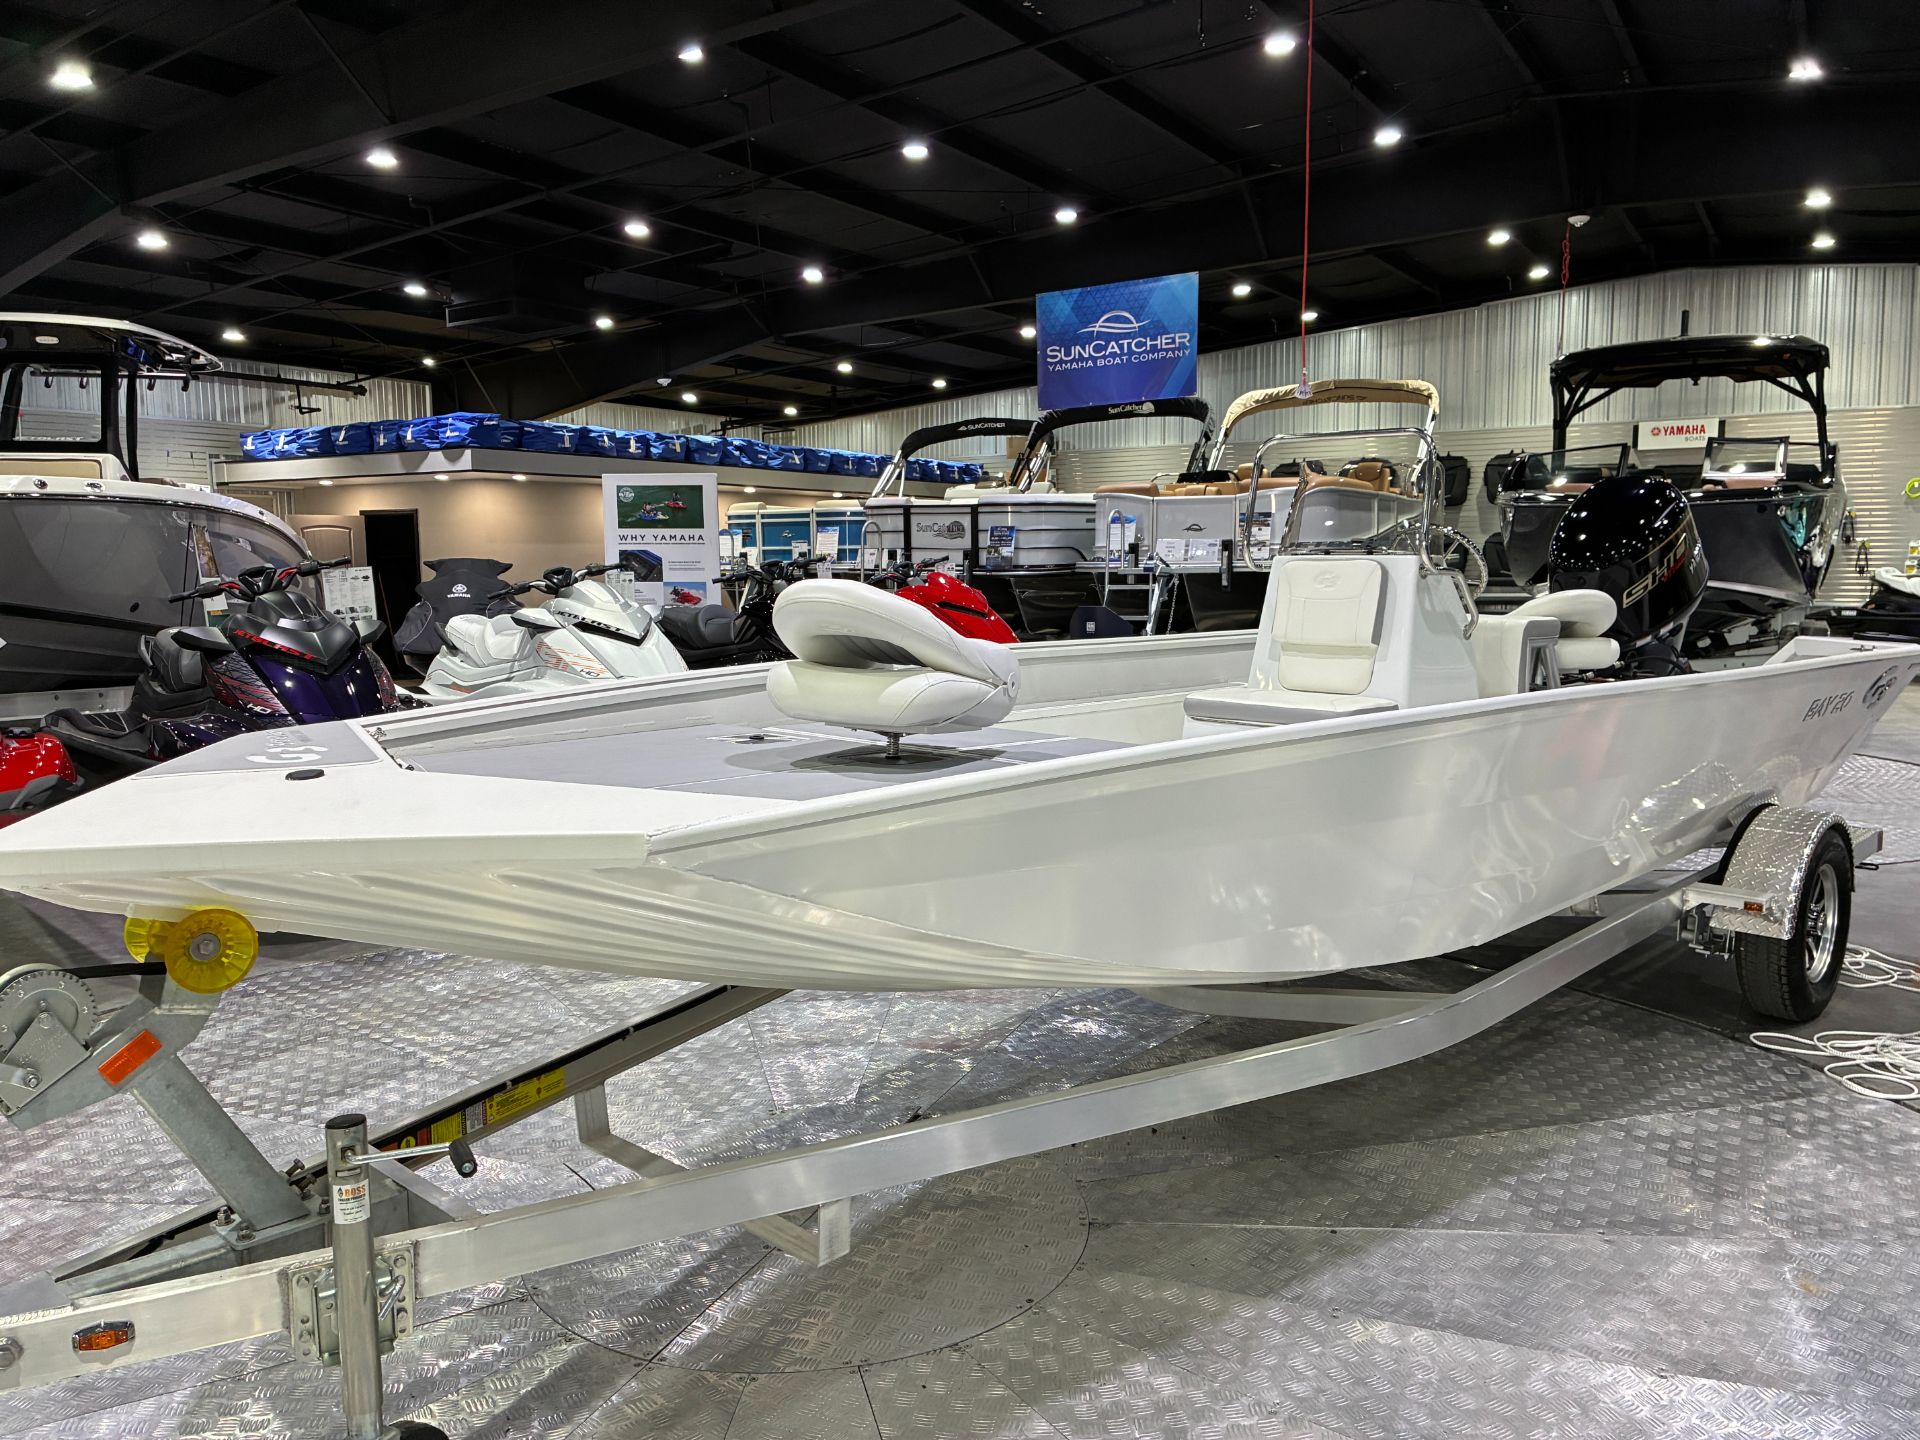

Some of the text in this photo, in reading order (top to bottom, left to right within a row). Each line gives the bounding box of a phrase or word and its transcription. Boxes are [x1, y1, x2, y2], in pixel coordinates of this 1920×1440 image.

[1046, 332, 1191, 363] SUNCATCHER
[1047, 349, 1191, 372] YAMAHA BOAT COMPANY
[1662, 424, 1706, 436] YAMAHA
[618, 534, 705, 542] WHY YAMAHA
